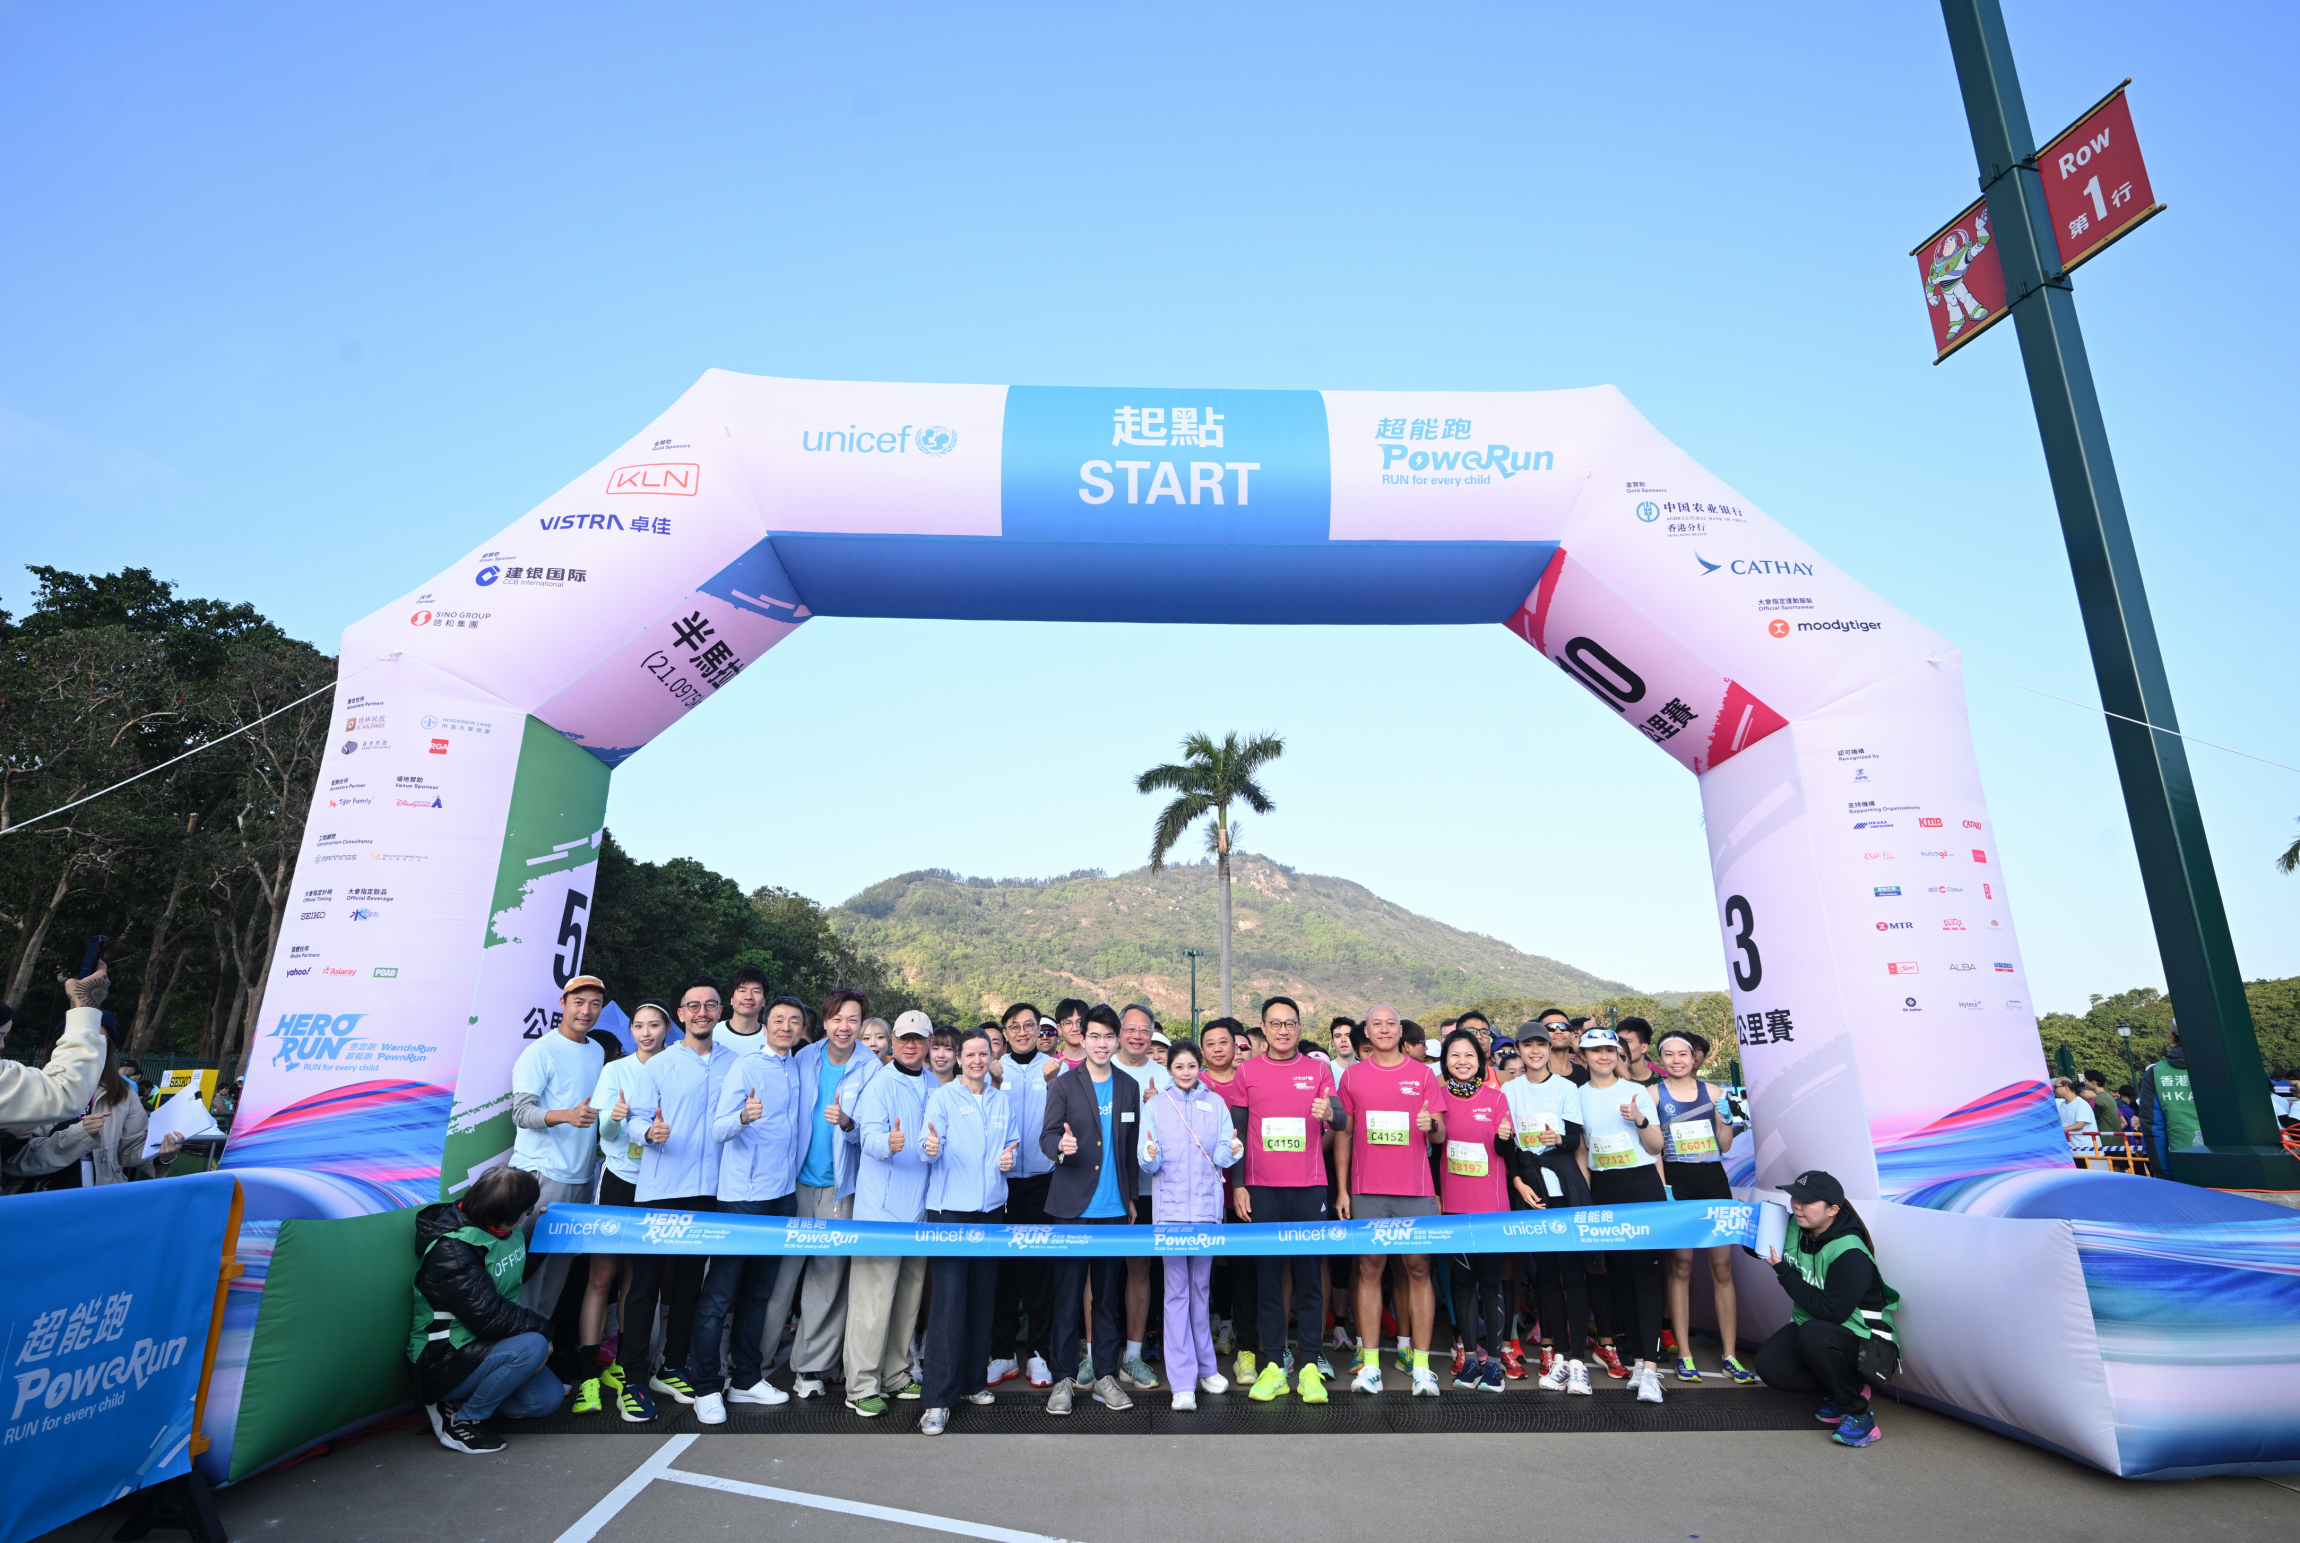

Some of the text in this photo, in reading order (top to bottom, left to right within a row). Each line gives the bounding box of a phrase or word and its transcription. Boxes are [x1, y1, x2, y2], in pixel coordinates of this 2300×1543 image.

[1111, 405, 1225, 448] 起點
[1375, 417, 1472, 440] 超能跑
[802, 424, 913, 454] unicef
[617, 469, 689, 488] KLN
[1078, 459, 1260, 505] START
[1382, 474, 1490, 487] RUN for every child
[1663, 501, 1743, 517] 中国农业银行
[540, 514, 672, 535] VISTRA 卓佳
[1668, 522, 1705, 533] 香港分行
[1730, 559, 1814, 576] CATHAY
[504, 567, 587, 582] 建银国际
[520, 579, 564, 588] International
[433, 619, 479, 629] 信和集團
[1797, 619, 1881, 632] moodytiger
[1555, 636, 1646, 713] 10
[443, 718, 475, 726] HENDERSON
[1918, 818, 1943, 827] KMB
[300, 911, 326, 920] SEIKO
[1889, 922, 1914, 930] MTR
[553, 888, 588, 990] 5
[1725, 894, 1763, 992] 3
[286, 967, 312, 978] yahoo!
[330, 968, 357, 977] Asiaray
[1949, 963, 1977, 971] ALBA
[1959, 1001, 1977, 1009] Hytera
[264, 1013, 370, 1037] HERO
[272, 1037, 371, 1072] RUN
[303, 1063, 321, 1071] RUN
[322, 1063, 333, 1071] for
[1370, 1118, 1375, 1127] 5
[1520, 1122, 1526, 1131] 5
[1371, 1132, 1403, 1141] C4152
[1524, 1134, 1542, 1144] C61
[1675, 1130, 1682, 1139] 5
[1267, 1139, 1300, 1148] C4150
[1593, 1143, 1599, 1152] 5
[1680, 1139, 1711, 1151] C6017
[1450, 1148, 1455, 1157] 5
[1599, 1153, 1631, 1165] C7121
[1451, 1161, 1482, 1173] C8197
[1574, 1210, 1614, 1223] 超能跑
[1699, 1206, 1754, 1219] HERO
[633, 1213, 697, 1226] HERO
[786, 1218, 827, 1229] 超能跑
[1358, 1218, 1418, 1229] HERO
[548, 1219, 601, 1235] unicef
[1502, 1220, 1548, 1236] unicef
[1712, 1217, 1751, 1237] RUN
[642, 1225, 698, 1244] RUN
[915, 1227, 964, 1242] unicef
[1008, 1232, 1059, 1249] RUN
[1278, 1226, 1327, 1242] unicef
[1371, 1228, 1421, 1246] RUN
[15, 1291, 133, 1367] 超能跑
[4, 1390, 126, 1445] RUN for every child
